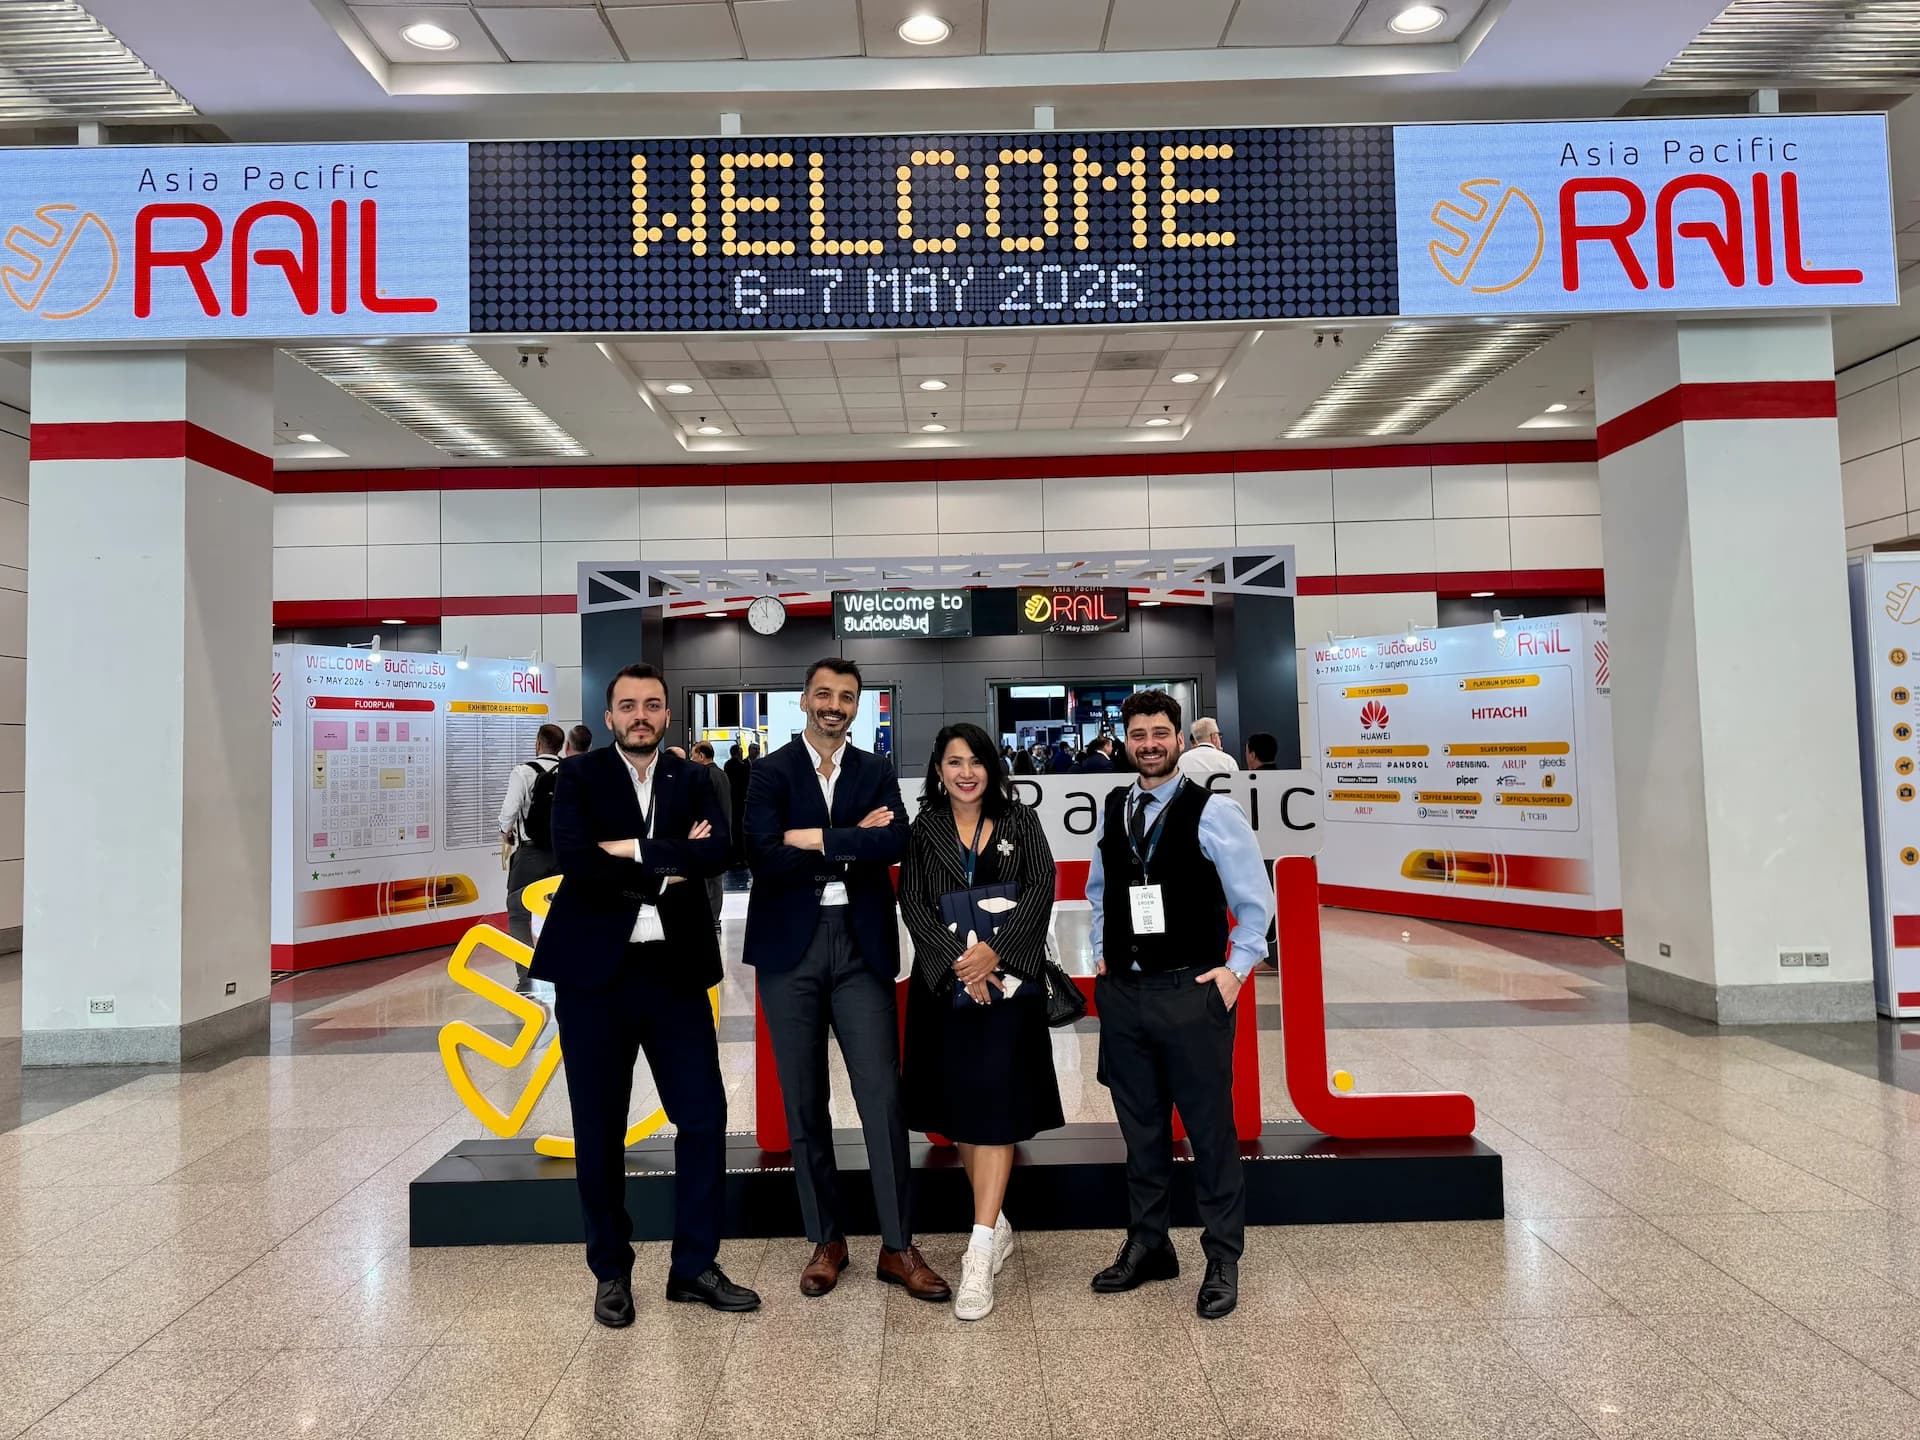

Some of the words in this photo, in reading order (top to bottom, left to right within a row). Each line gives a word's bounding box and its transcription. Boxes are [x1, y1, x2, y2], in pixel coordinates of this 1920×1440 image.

[1560, 141, 1640, 168] Asia
[1664, 136, 1799, 166] Pacific
[139, 166, 219, 193] Asia
[244, 163, 380, 192] Pacific
[632, 143, 1237, 257] WELCOME
[1559, 171, 1864, 292] RAIL
[134, 199, 438, 319] RAIL
[867, 265, 975, 314] MAY
[998, 262, 1145, 311] 2026
[843, 593, 935, 612] Welcome
[941, 593, 963, 610] to
[1053, 594, 1118, 621] RAIL
[1517, 629, 1571, 656] RAIL
[306, 655, 373, 672] WELCOME
[1330, 665, 1343, 673] MAY
[1345, 664, 1361, 672] 2026
[1420, 657, 1438, 666] 2569
[326, 676, 342, 685] MAY
[344, 677, 364, 686] 2026
[428, 681, 446, 690] 2569
[512, 672, 549, 694] RAIL
[355, 700, 395, 709] FLOORPLAN
[499, 705, 529, 713] DIRECTORY
[1472, 706, 1528, 719] HITACHI
[1360, 732, 1391, 741] HUAWEI
[1387, 761, 1429, 769] PANDROL
[1502, 759, 1527, 769] ARUP
[1387, 776, 1417, 784] SIEMENS
[1456, 775, 1479, 787] piper
[1354, 807, 1373, 815] ARUP
